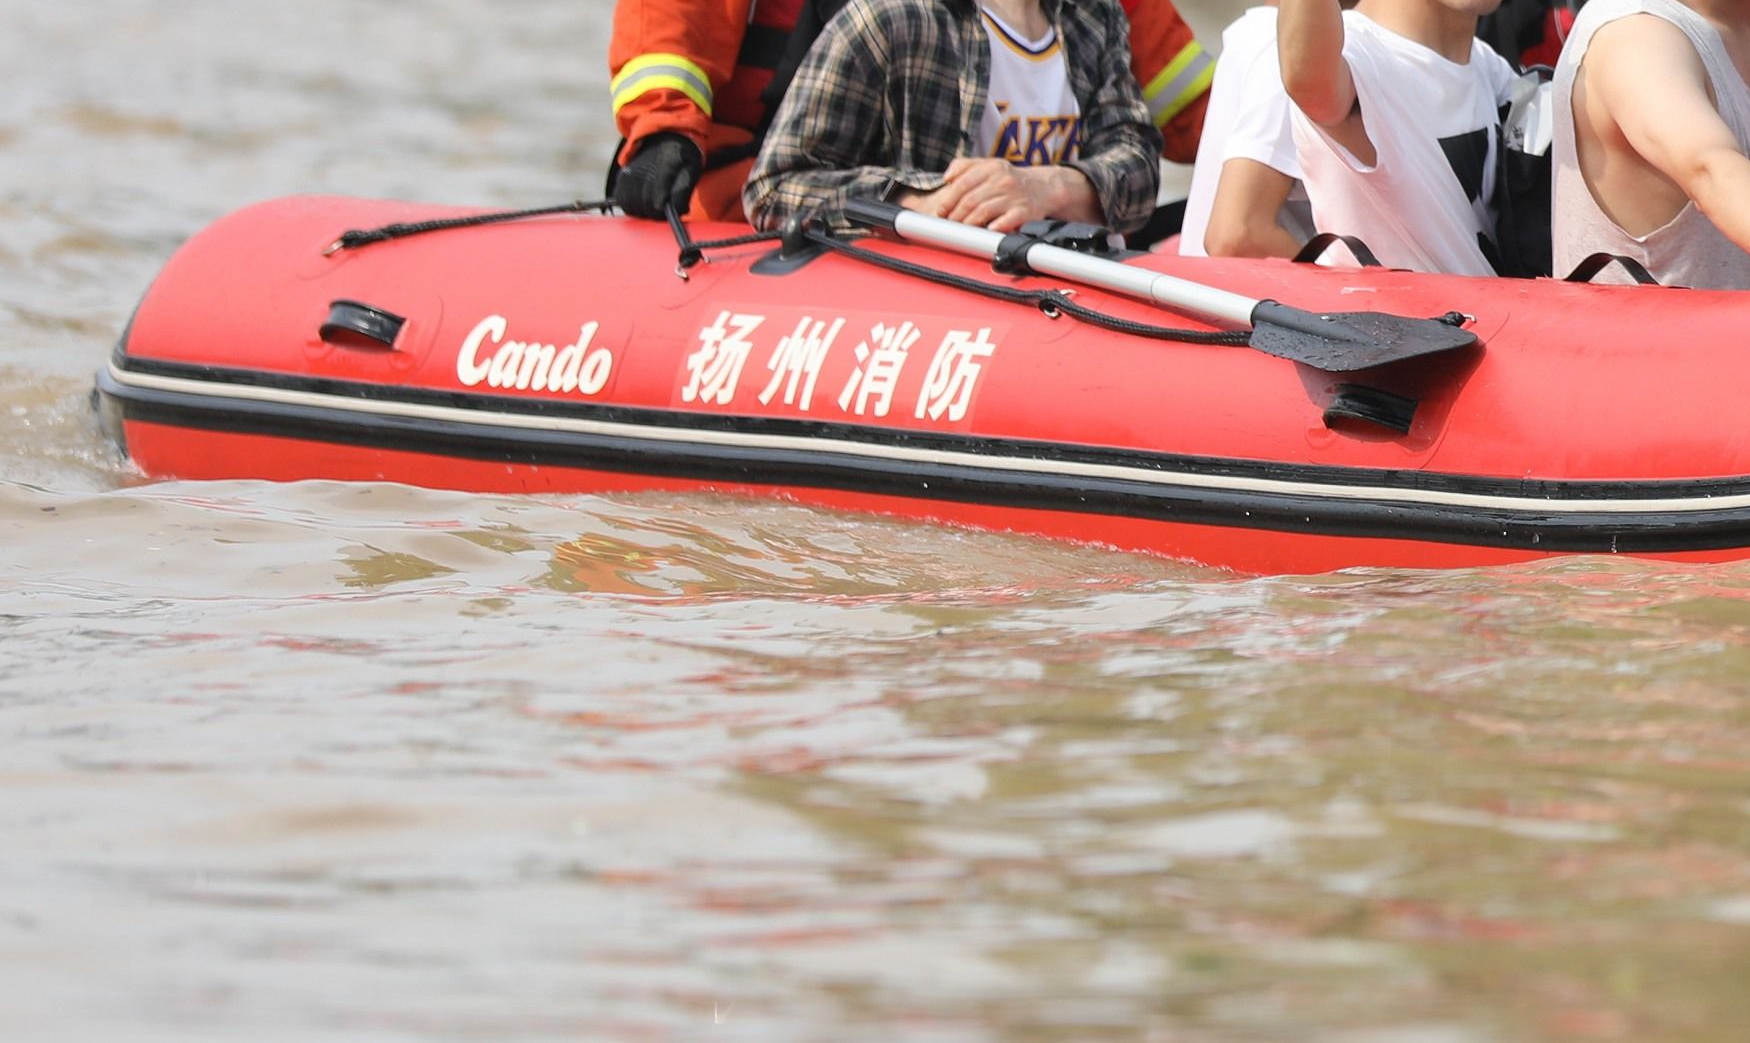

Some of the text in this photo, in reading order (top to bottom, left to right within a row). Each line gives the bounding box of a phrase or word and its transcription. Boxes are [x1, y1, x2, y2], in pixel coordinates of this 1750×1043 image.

[456, 315, 612, 395] Cando
[681, 310, 995, 422] 扬州消防
